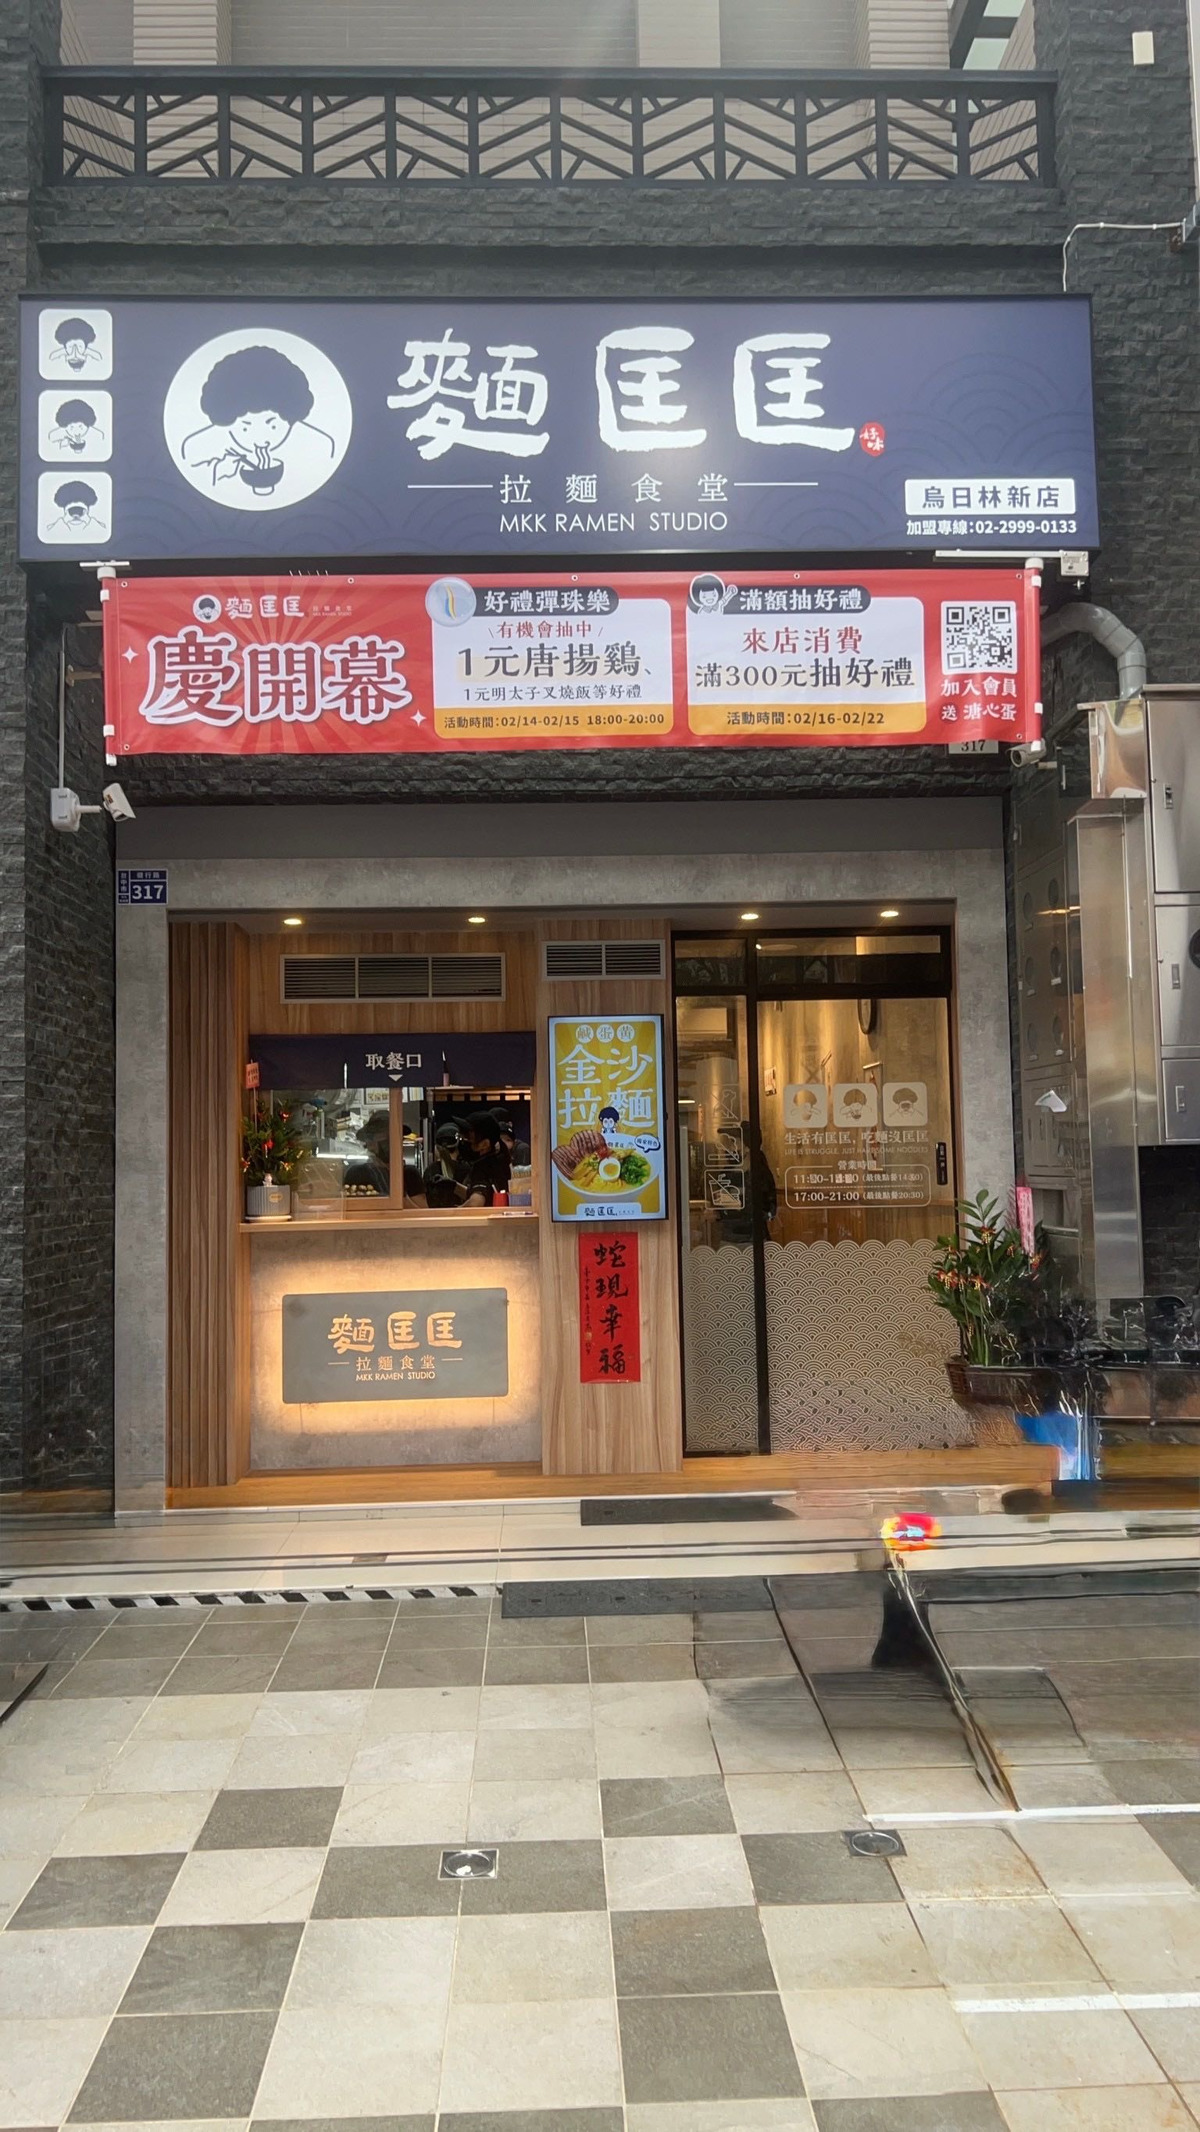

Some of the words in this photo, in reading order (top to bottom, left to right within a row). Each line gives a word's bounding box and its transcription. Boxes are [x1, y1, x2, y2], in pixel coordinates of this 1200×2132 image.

[860, 427, 884, 451] 好味
[500, 473, 728, 504] 拉麵食堂
[922, 485, 1060, 509] 烏日林新店
[500, 514, 547, 533] MKK
[555, 513, 635, 532] RAMEN
[649, 511, 728, 531] STUDIO
[484, 588, 611, 614] 好禮彈珠樂
[739, 588, 863, 611] 滿額抽好禮
[496, 620, 592, 638] 有機會抽中
[742, 626, 862, 654] 來店消費
[140, 626, 412, 727] 慶開幕
[695, 657, 915, 688] 滿300元抽好禮
[941, 676, 1018, 697] 加入會員
[587, 713, 664, 726] 18:00-20:00
[942, 705, 958, 721] 送
[132, 884, 164, 900] 317
[365, 1051, 422, 1071] 取餐口
[557, 1044, 653, 1086] 金沙
[558, 1087, 655, 1129] 拉麵
[794, 1191, 860, 1202] 17:00-21:00
[356, 1355, 436, 1371] 拉麵食堂
[355, 1373, 373, 1382] MKK
[375, 1372, 403, 1381] RAMEN
[407, 1371, 436, 1380] STUDIO
